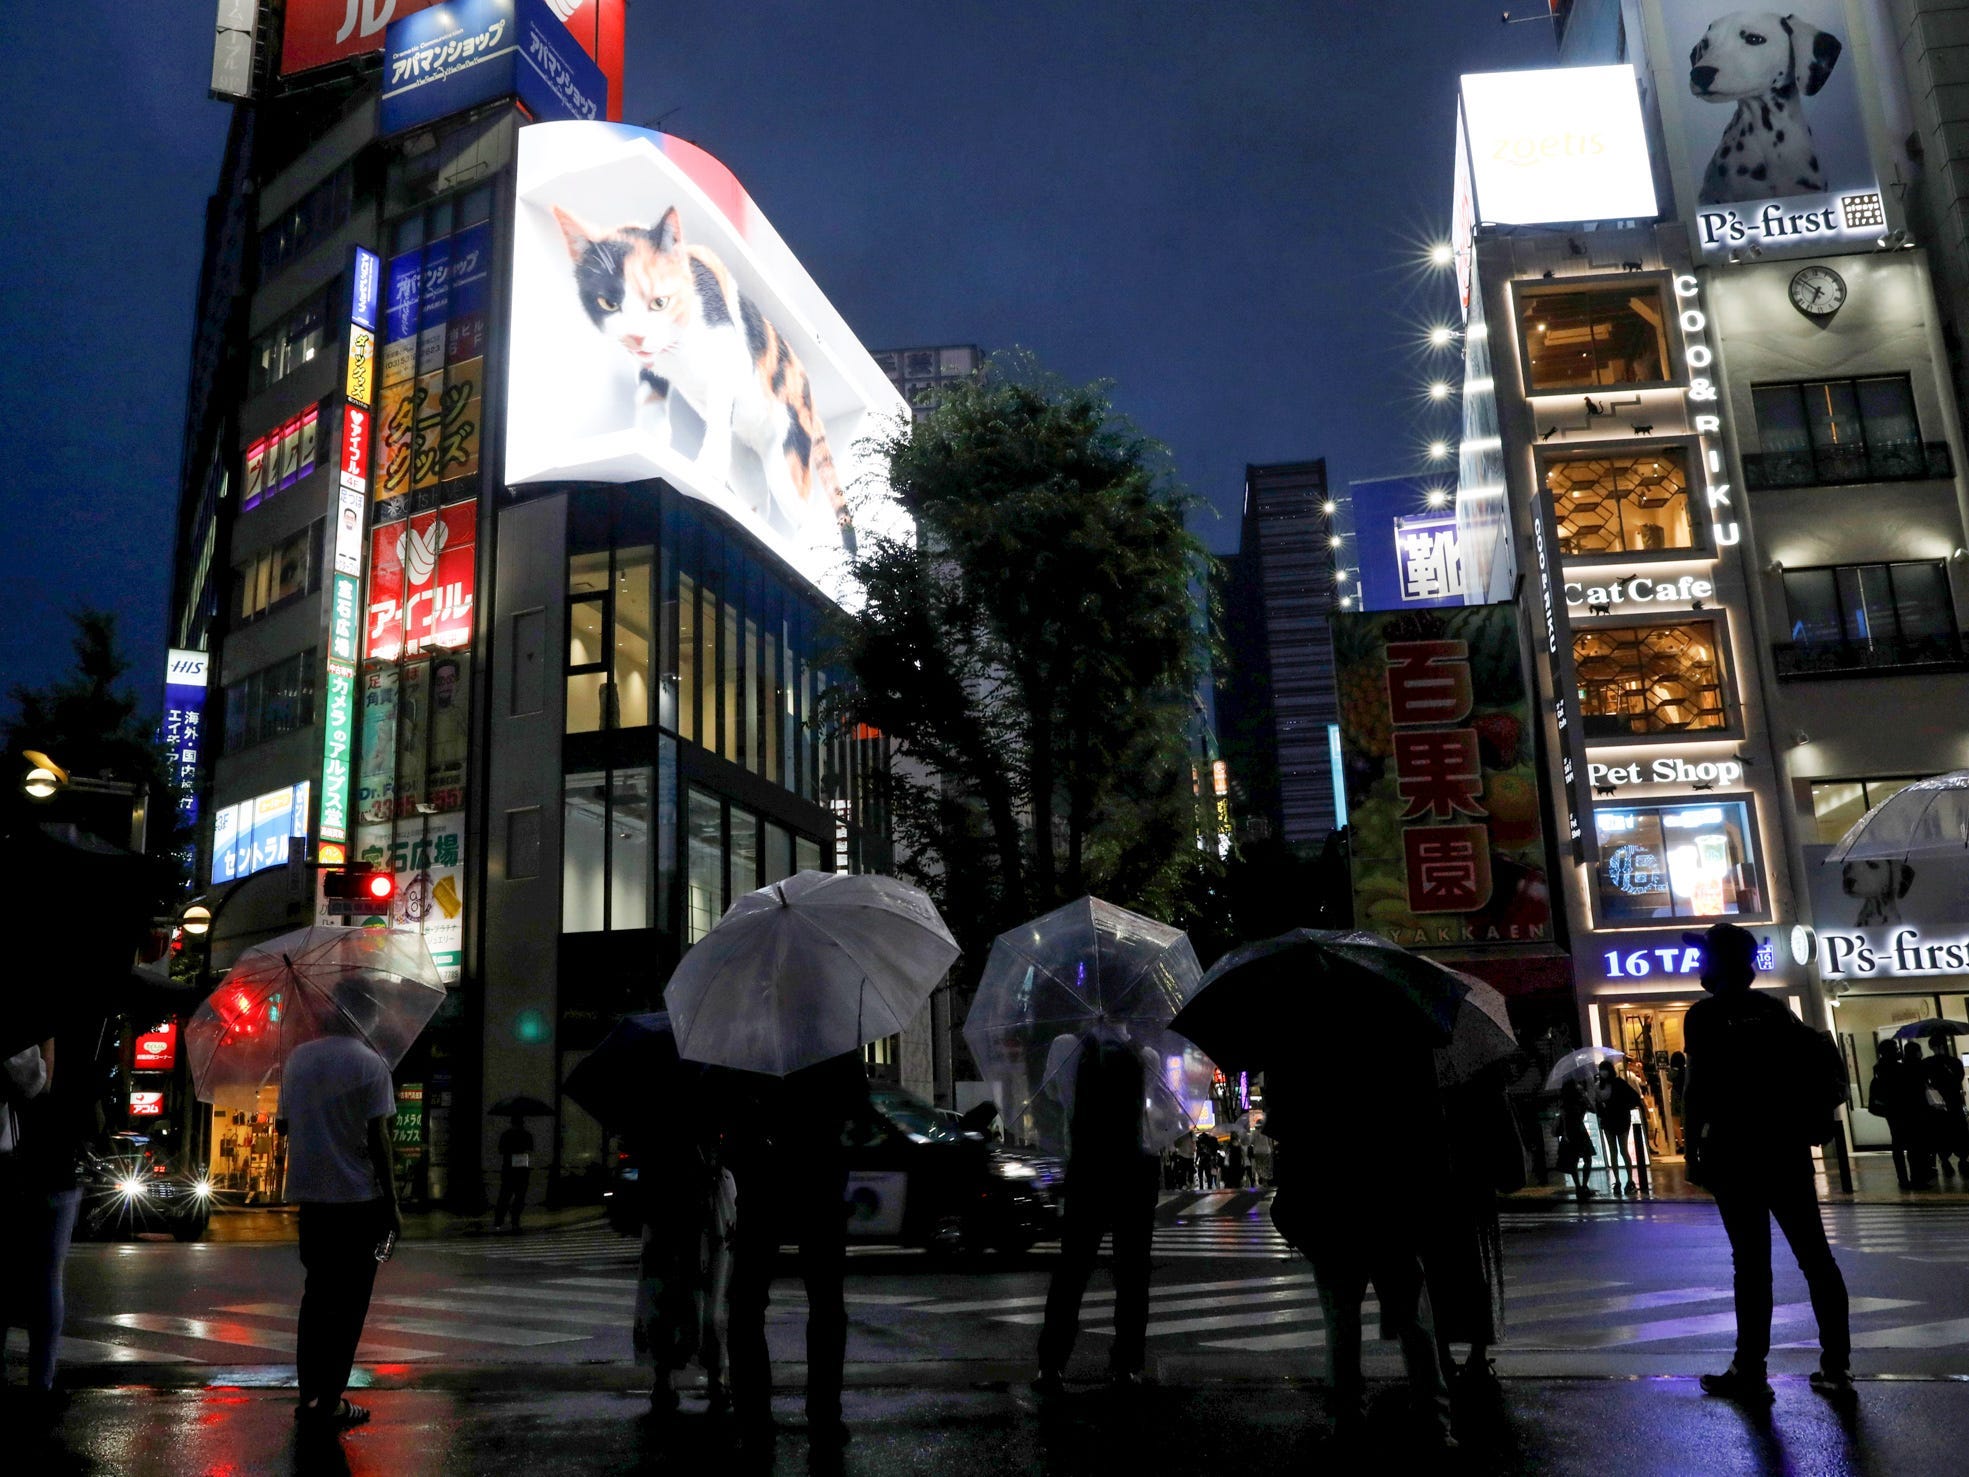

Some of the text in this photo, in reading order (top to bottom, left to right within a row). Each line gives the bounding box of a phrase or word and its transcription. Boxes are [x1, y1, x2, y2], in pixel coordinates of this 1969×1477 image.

[391, 19, 506, 84] アパマンショップ
[530, 30, 597, 121] アパマンショップ
[1492, 131, 1606, 162] zoetis
[1700, 205, 1838, 244] P's-first
[352, 334, 369, 399] ダーツグッズ
[347, 424, 363, 475] アイフル
[372, 582, 473, 639] アイフル
[1565, 576, 1712, 606] Cat Cafe
[171, 660, 204, 674] HIS
[323, 676, 349, 827] カメラのアルプス堂
[1588, 762, 1644, 786] Pet
[1653, 758, 1740, 786] Shop
[1385, 639, 1493, 914] 百果園
[361, 833, 459, 873] 宝石広場
[1604, 950, 1650, 977] 16
[1822, 930, 1969, 973] P's-firs
[133, 1104, 159, 1113] アコム
